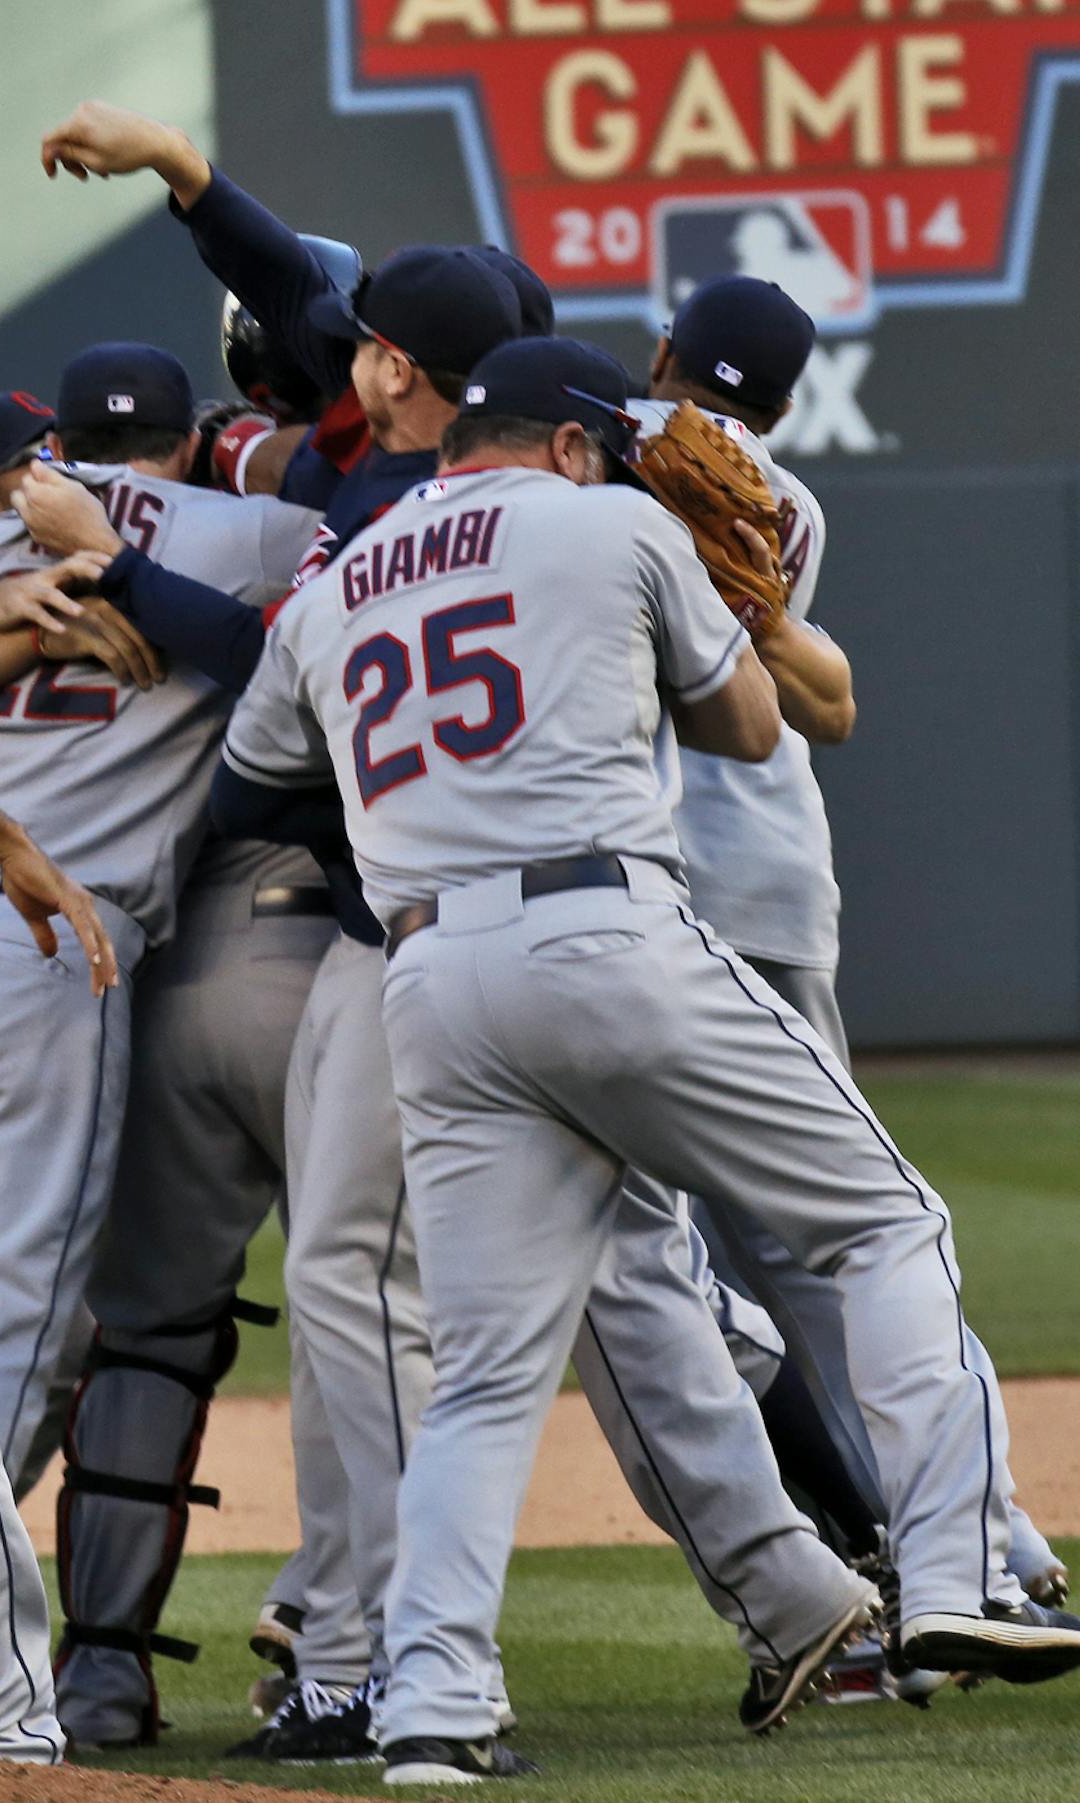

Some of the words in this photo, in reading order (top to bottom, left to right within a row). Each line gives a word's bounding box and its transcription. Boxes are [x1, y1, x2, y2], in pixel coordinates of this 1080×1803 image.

[544, 34, 978, 180] GAME
[552, 207, 642, 268] 20
[885, 195, 965, 253] 14
[342, 507, 503, 611] GIAMBI
[343, 592, 526, 812] 25
